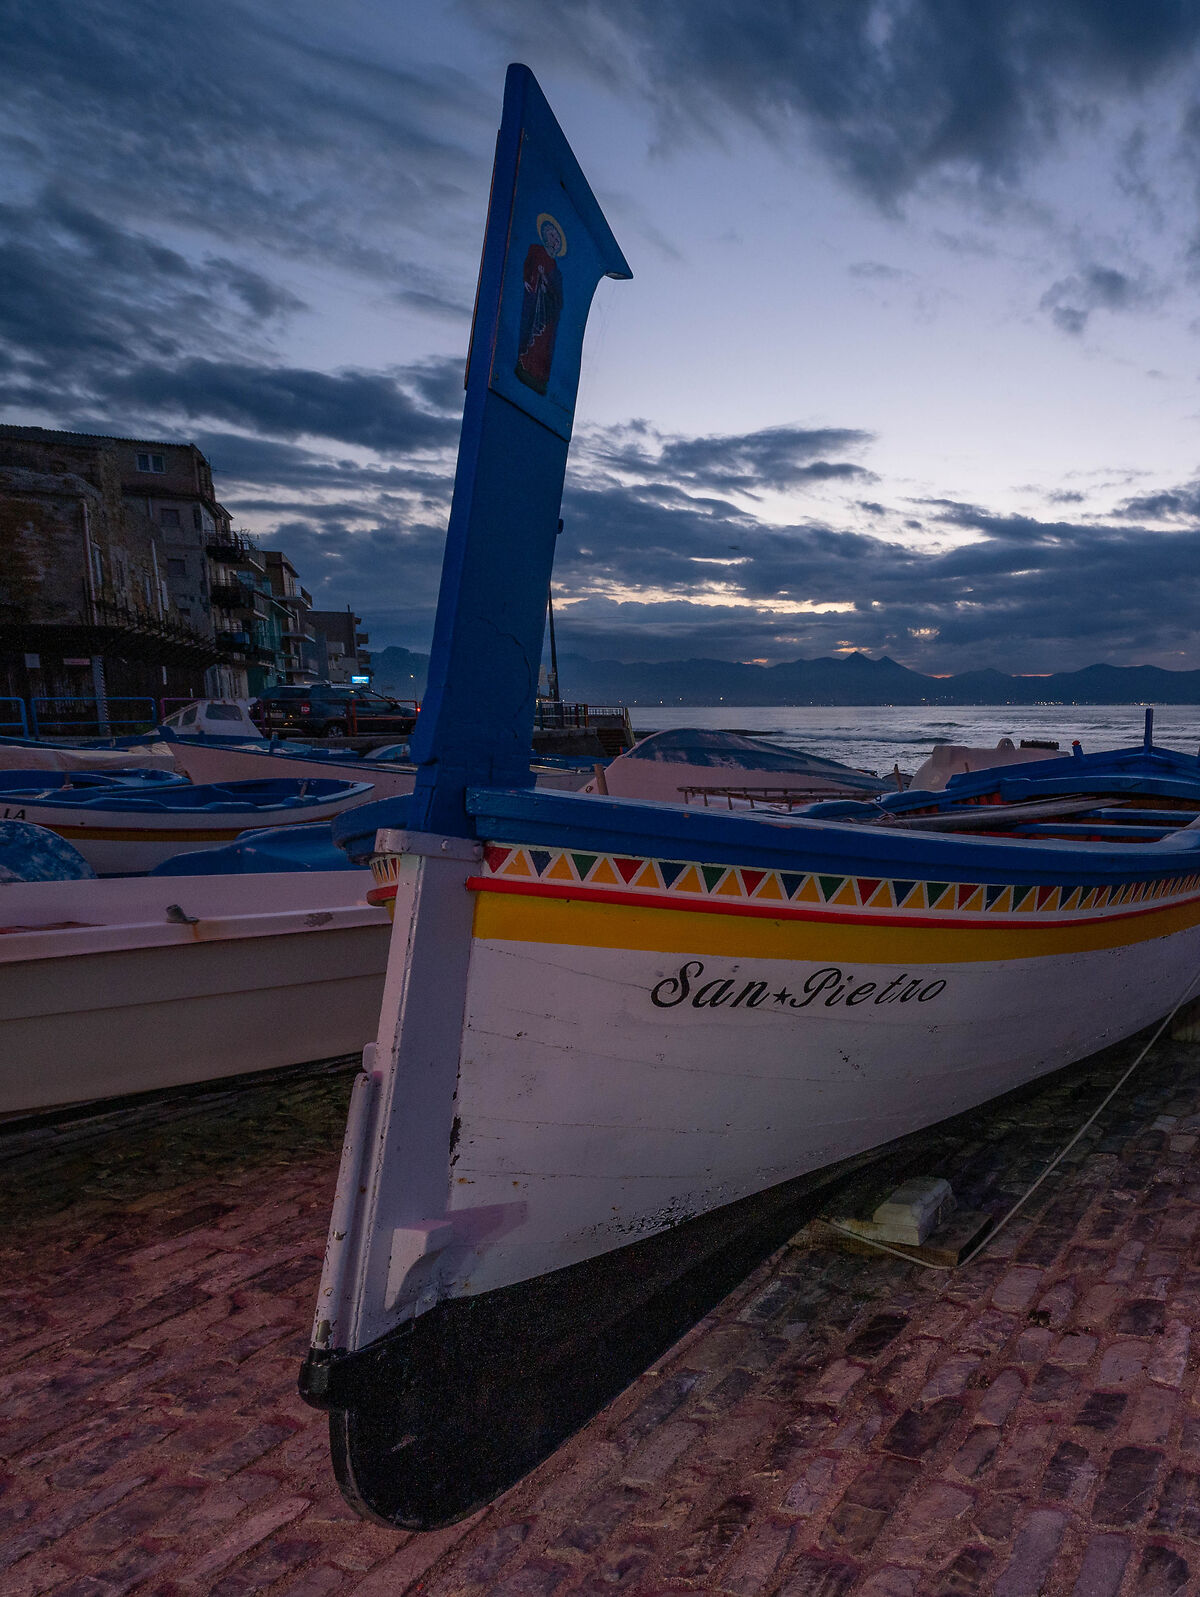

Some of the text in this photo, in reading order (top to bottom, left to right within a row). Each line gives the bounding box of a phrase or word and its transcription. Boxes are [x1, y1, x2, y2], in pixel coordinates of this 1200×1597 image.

[0, 808, 25, 820] LA
[650, 960, 947, 1008] San Pietro
